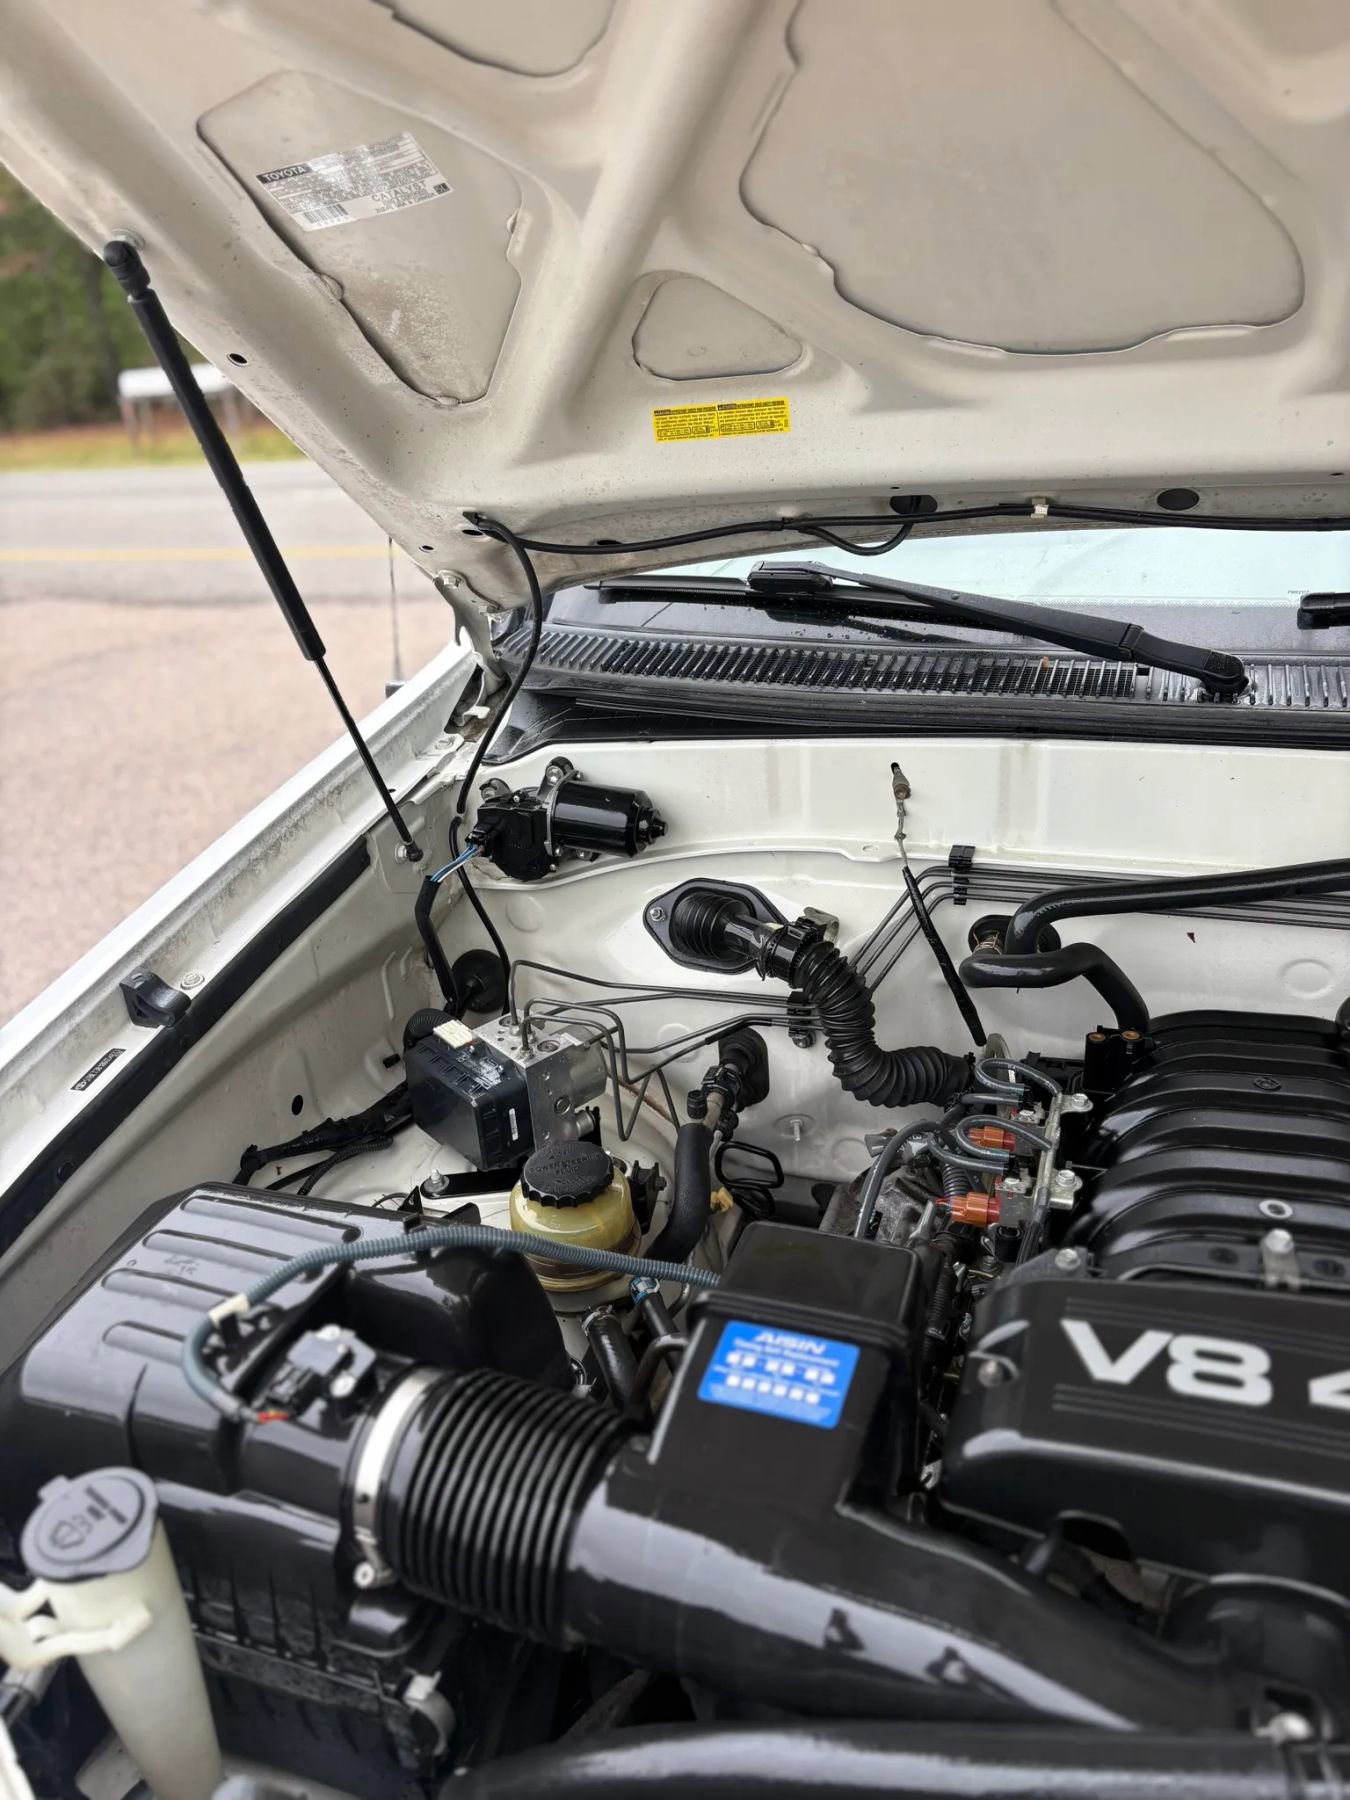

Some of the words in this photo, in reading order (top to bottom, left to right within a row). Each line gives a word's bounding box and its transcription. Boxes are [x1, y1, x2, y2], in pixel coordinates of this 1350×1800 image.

[263, 166, 307, 182] TOYOTA
[371, 180, 427, 202] CATALYST
[754, 1331, 827, 1354] AISIN
[1060, 1318, 1273, 1406] V8
